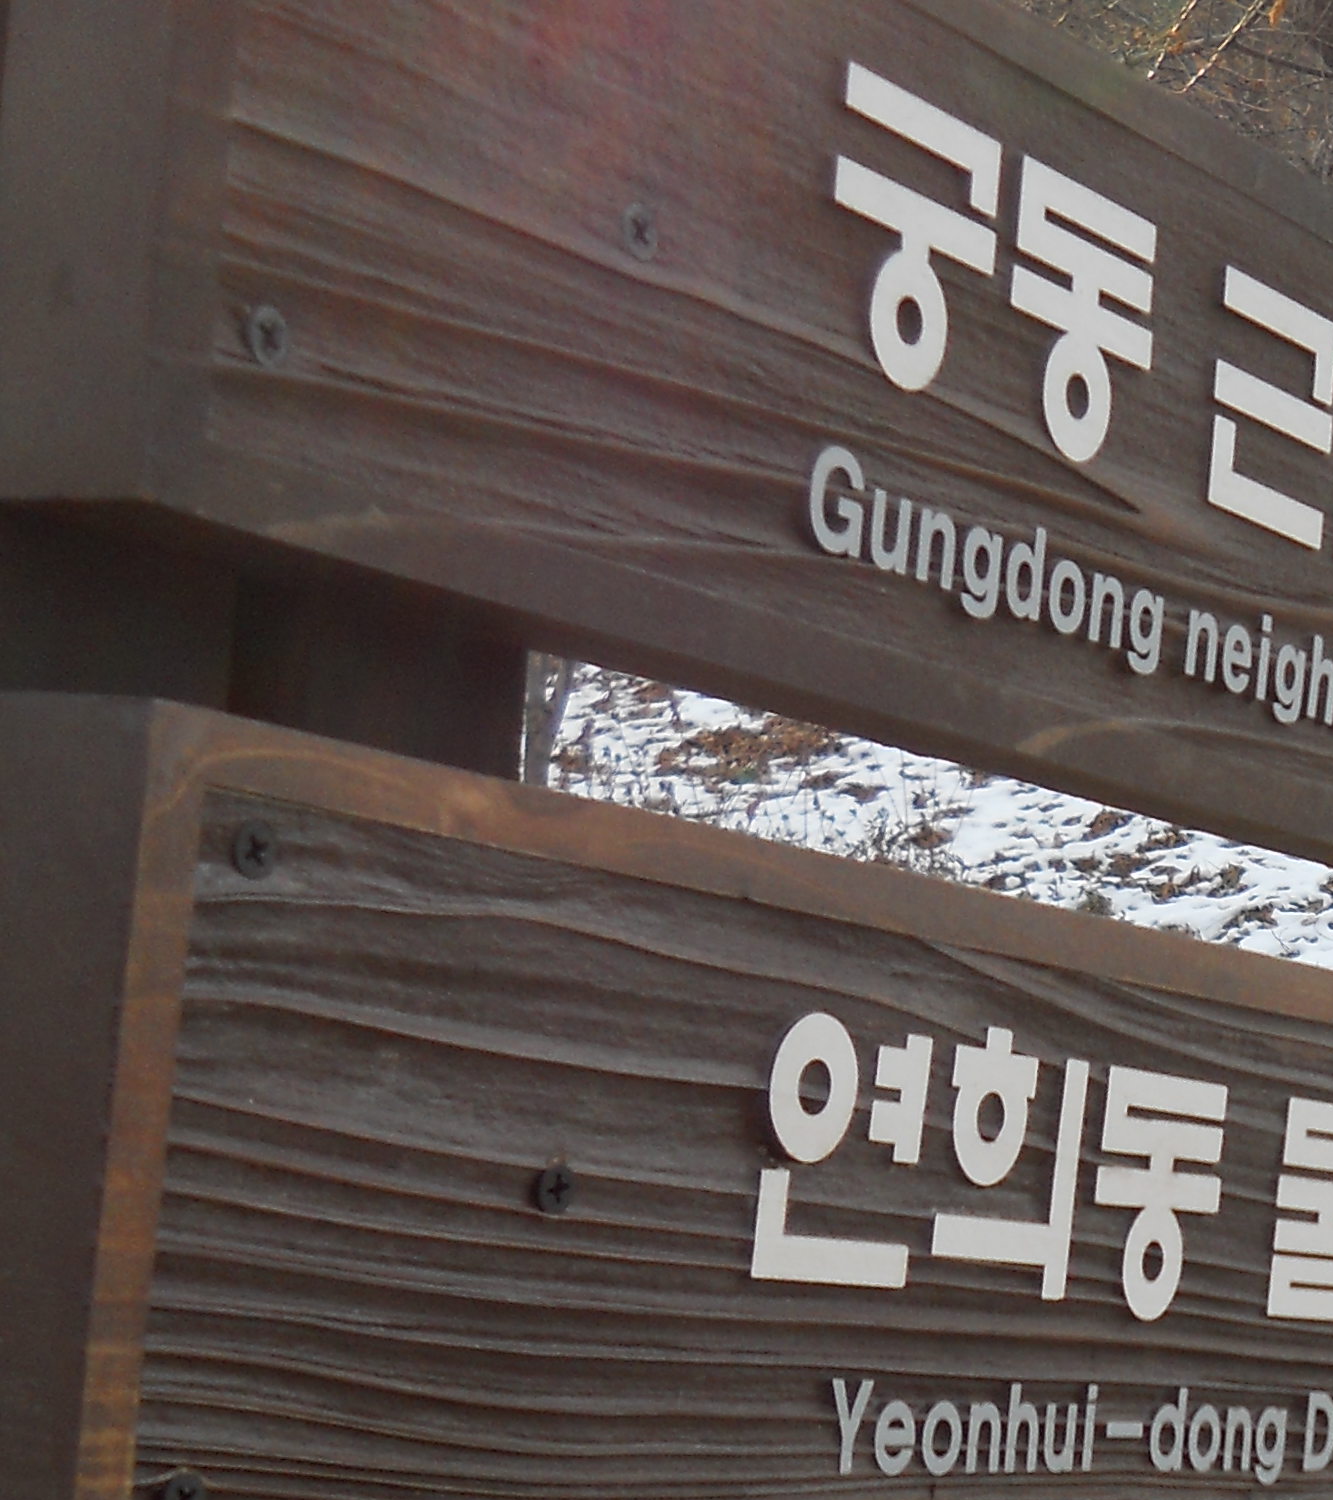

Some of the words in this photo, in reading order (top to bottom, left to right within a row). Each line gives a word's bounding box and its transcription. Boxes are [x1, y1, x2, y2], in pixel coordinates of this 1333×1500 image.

[835, 61, 1157, 463] 궁동
[809, 444, 1164, 676] Gungdong
[751, 1011, 1228, 1322] 연희동
[832, 1378, 1287, 1486] Yeonhui-dong
